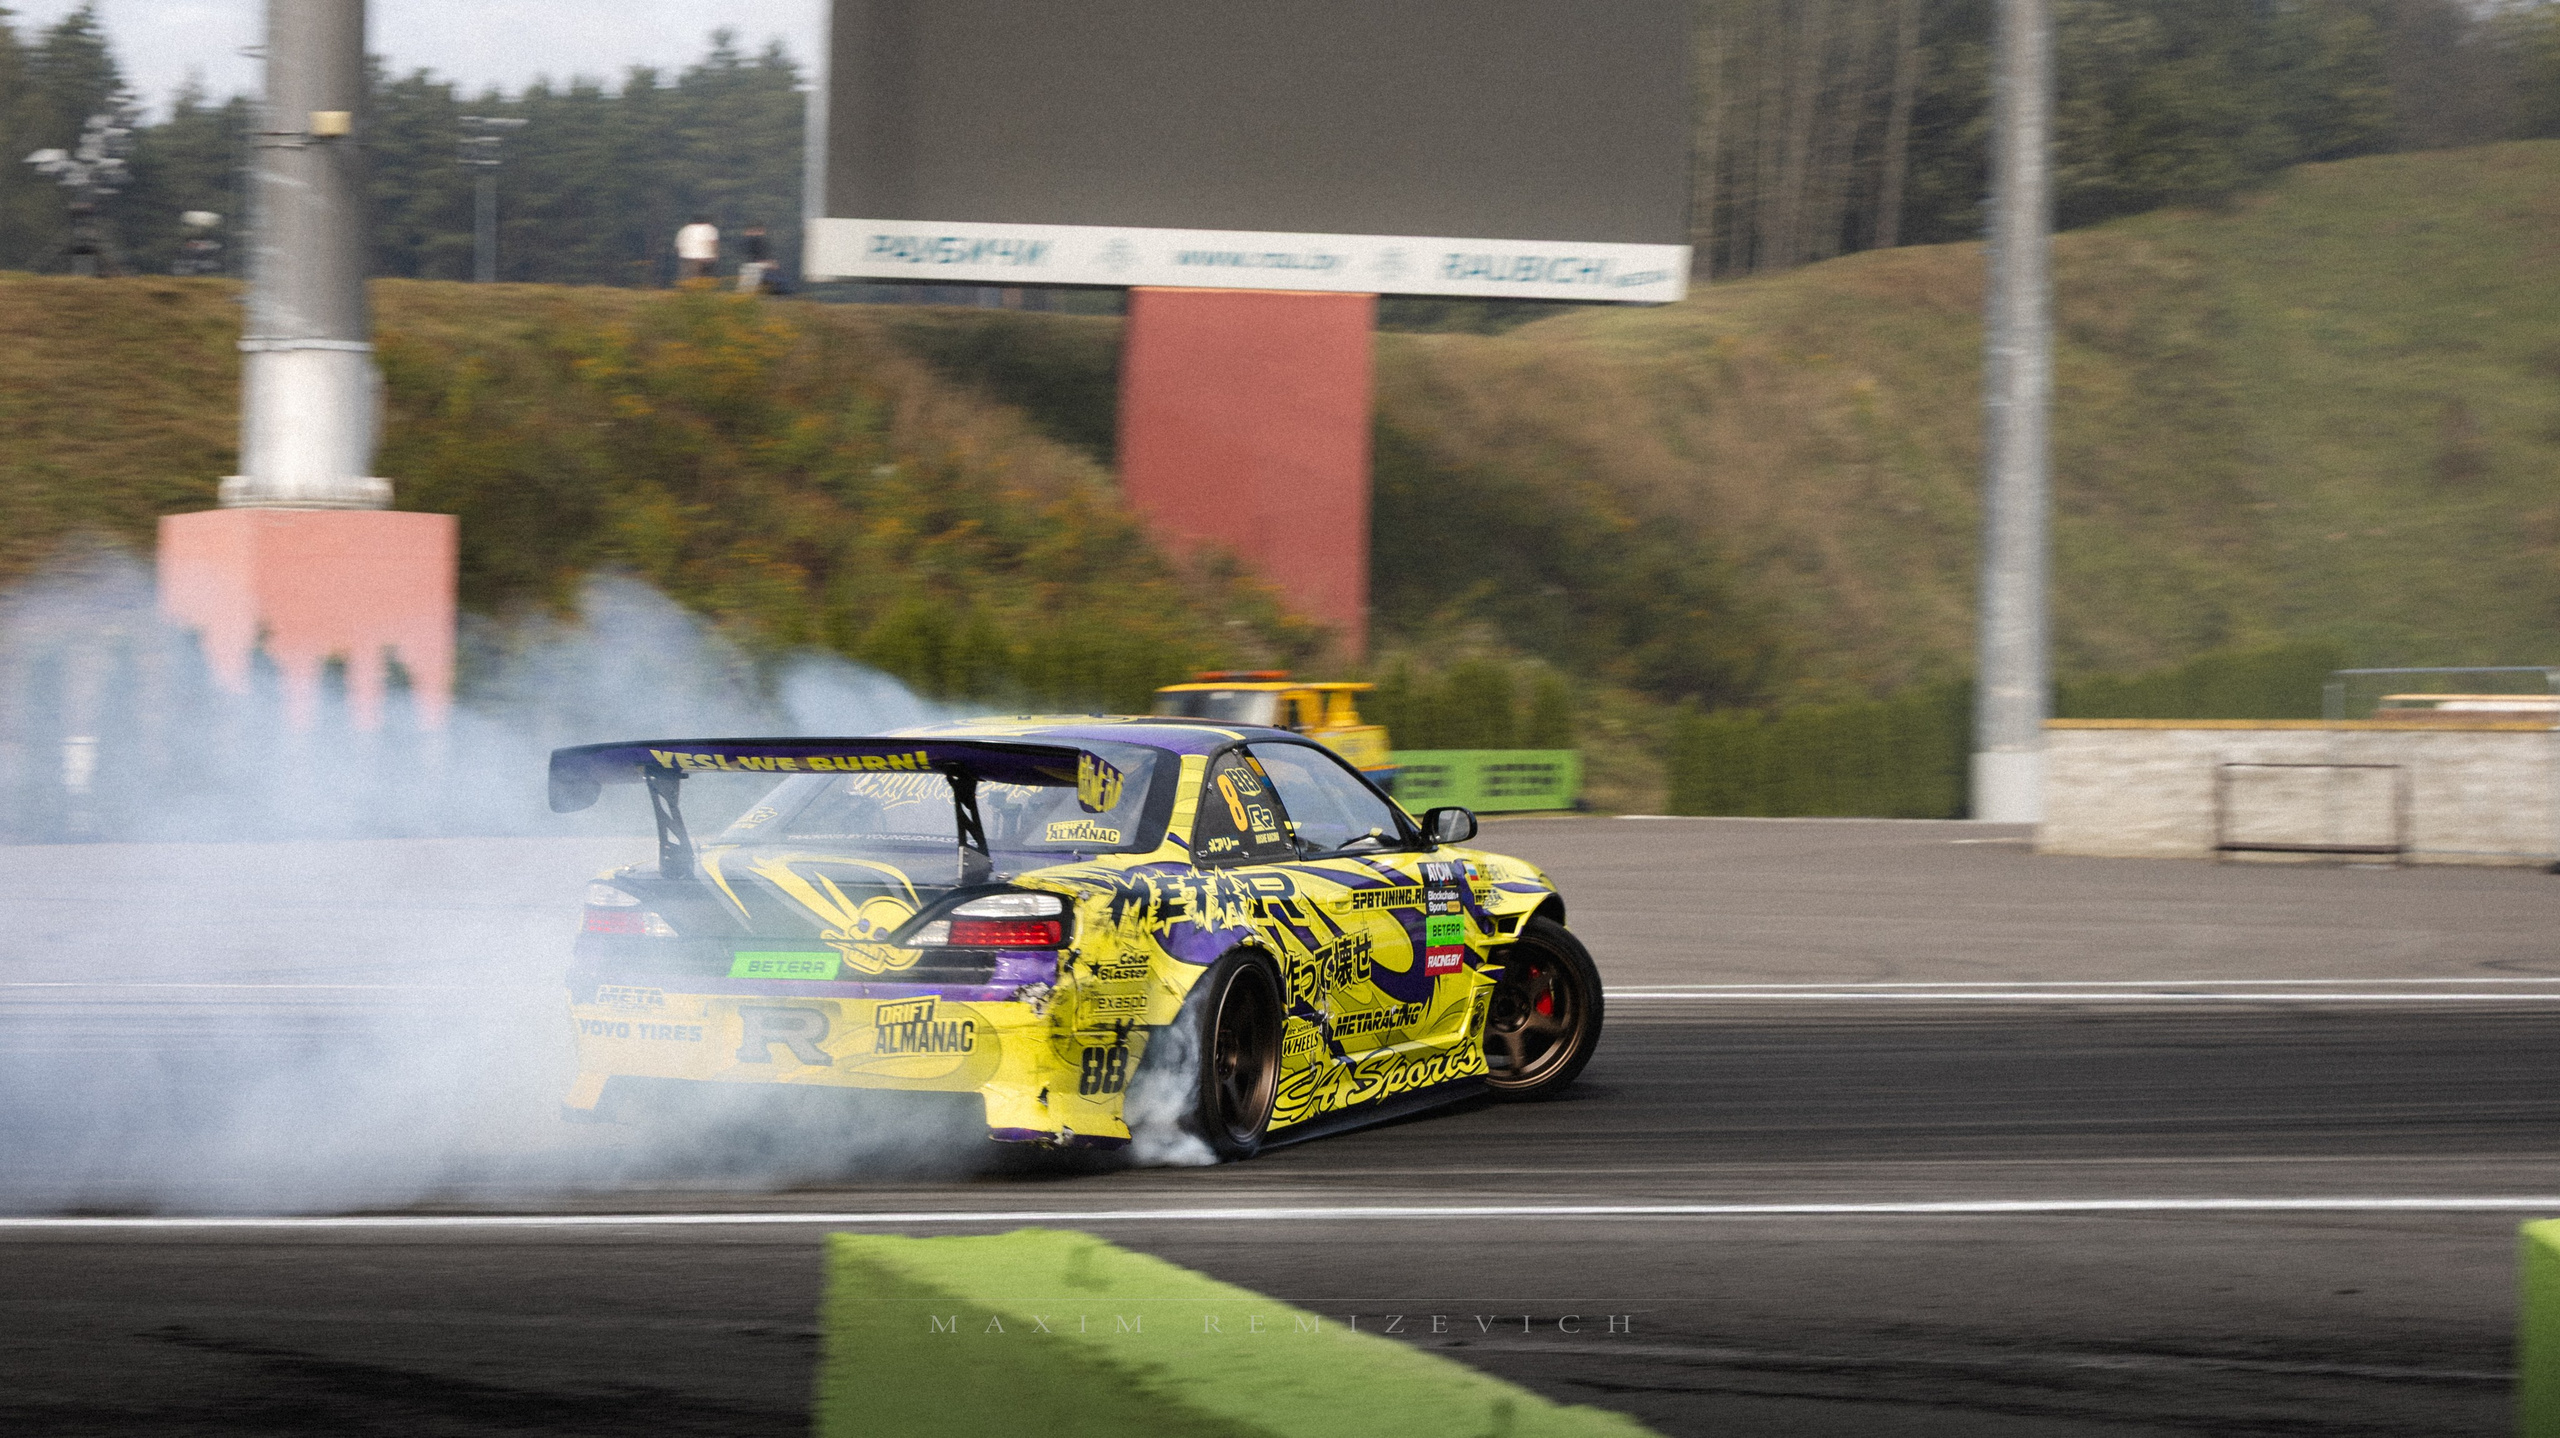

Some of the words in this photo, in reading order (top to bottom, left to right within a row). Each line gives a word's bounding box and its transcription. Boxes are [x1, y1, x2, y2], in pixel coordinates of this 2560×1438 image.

[650, 750, 732, 771] YES!
[737, 757, 800, 771] WE
[806, 751, 931, 771] BURN!
[1217, 774, 1248, 832] 8
[1049, 829, 1118, 843] ALMANAC
[1426, 863, 1454, 881] ATOM
[1428, 901, 1447, 913] Sports
[1120, 953, 1149, 965] Color
[1427, 954, 1461, 968] RACING.BY
[1101, 968, 1147, 981] Blaster
[878, 1002, 934, 1026] DRIFT
[1335, 1003, 1422, 1038] METARACING
[579, 1018, 630, 1039] YOYO
[638, 1023, 703, 1042] TIRES
[736, 1005, 833, 1067] R
[874, 1020, 975, 1055] ALMANAC
[1284, 1031, 1318, 1056] WHEELS
[1080, 1046, 1128, 1095] 88
[1347, 1037, 1481, 1105] Sports
